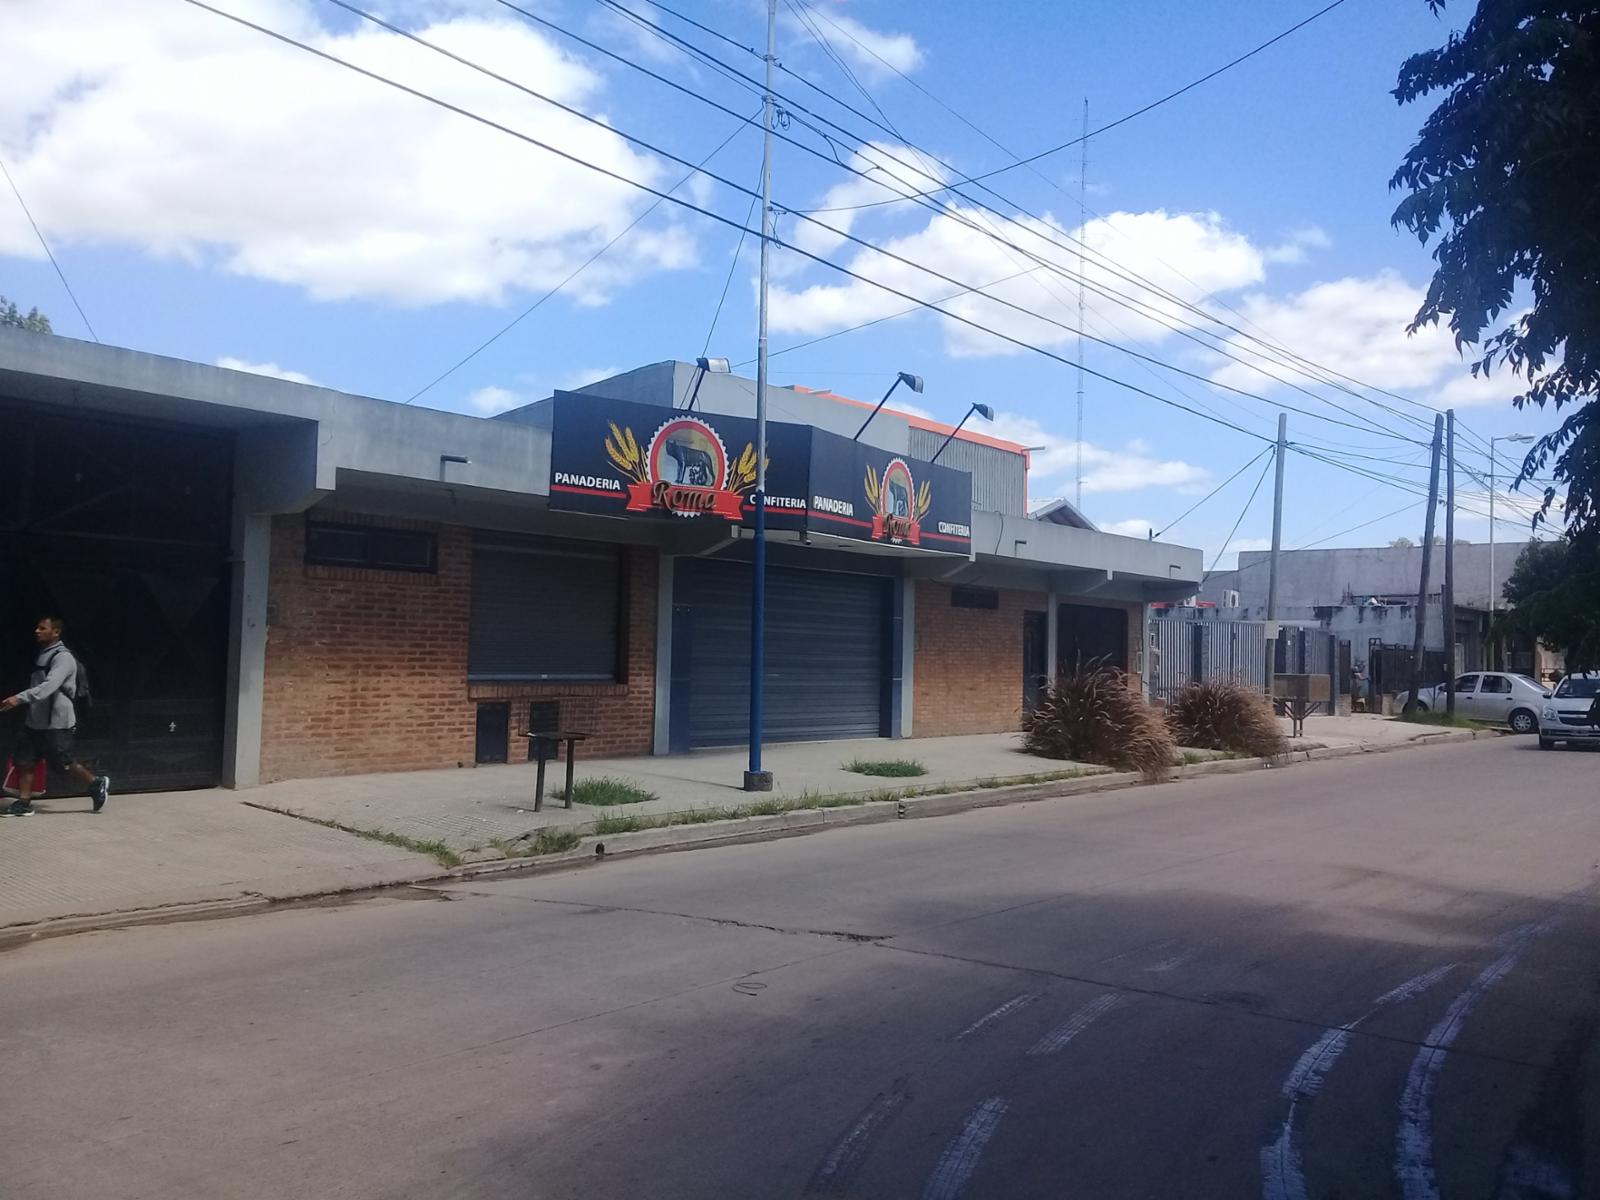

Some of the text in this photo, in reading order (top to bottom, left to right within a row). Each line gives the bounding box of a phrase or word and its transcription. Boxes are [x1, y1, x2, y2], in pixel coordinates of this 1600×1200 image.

[555, 472, 621, 491] PANADERIA
[653, 481, 717, 512] Roma
[749, 494, 807, 509] CNFITERIA
[813, 495, 854, 517] PANADERIA
[938, 521, 970, 537] CONFITERIA
